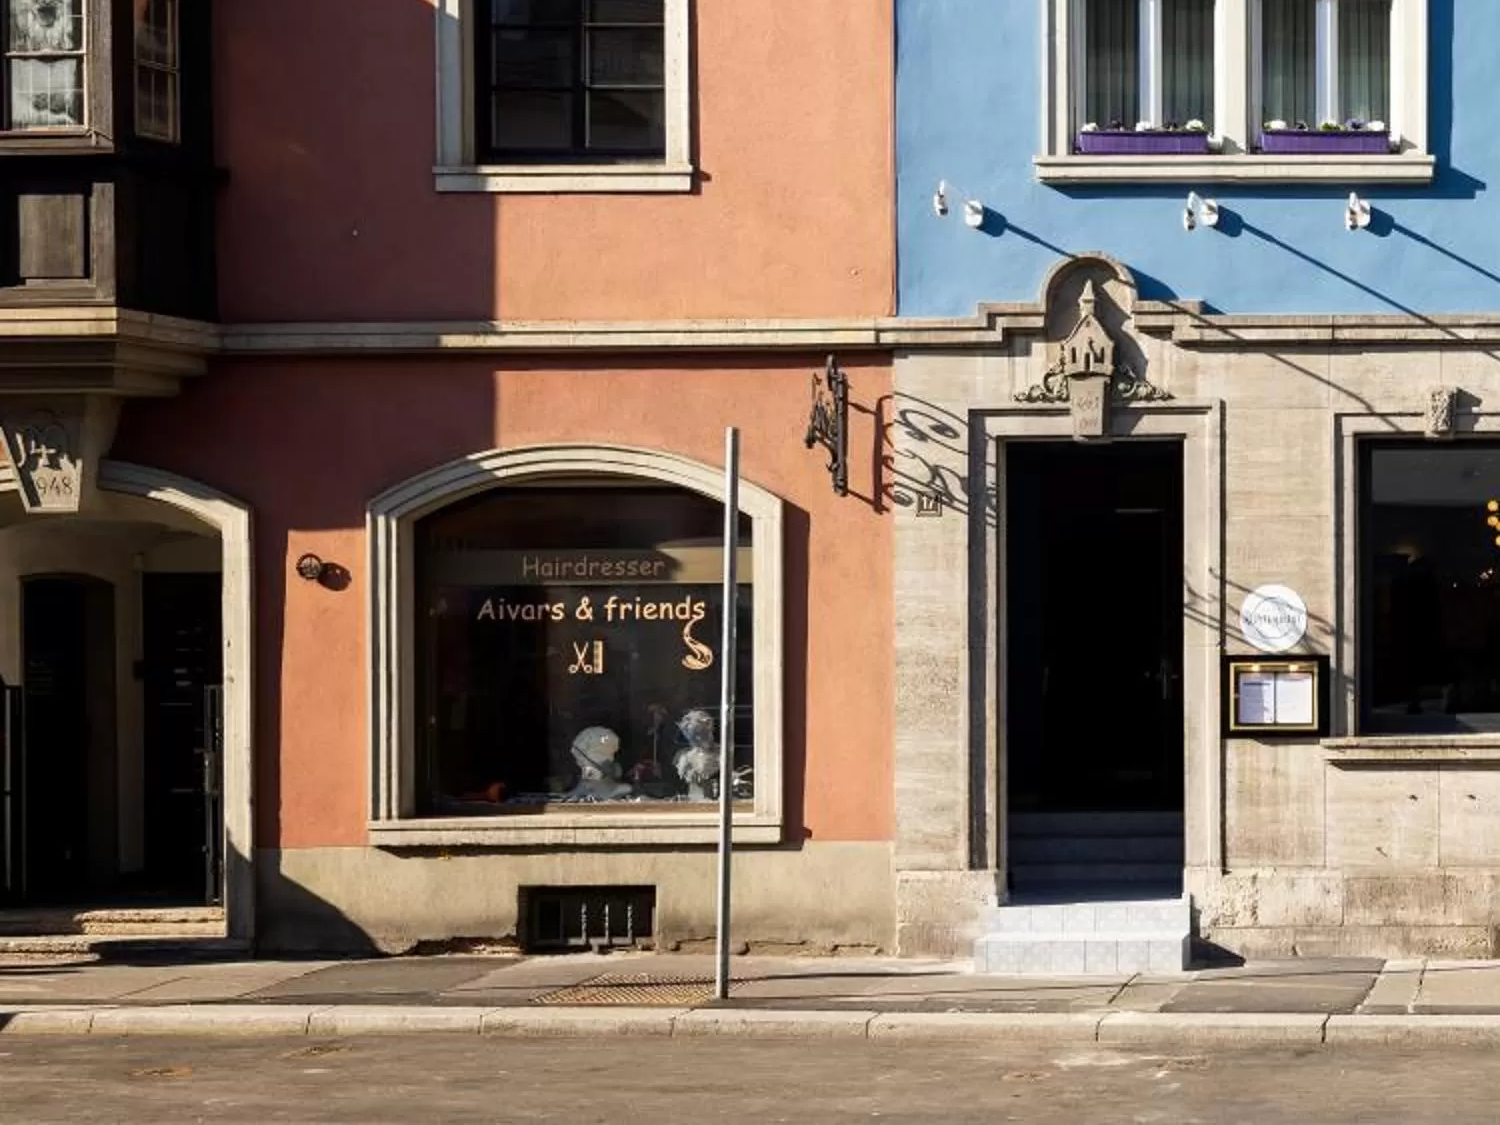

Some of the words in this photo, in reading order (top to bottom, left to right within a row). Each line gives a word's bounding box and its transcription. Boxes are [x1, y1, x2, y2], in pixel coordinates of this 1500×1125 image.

[522, 555, 666, 578] Hairdresser
[477, 597, 565, 621] Aivars
[575, 595, 593, 621] &
[603, 594, 706, 622] friends
